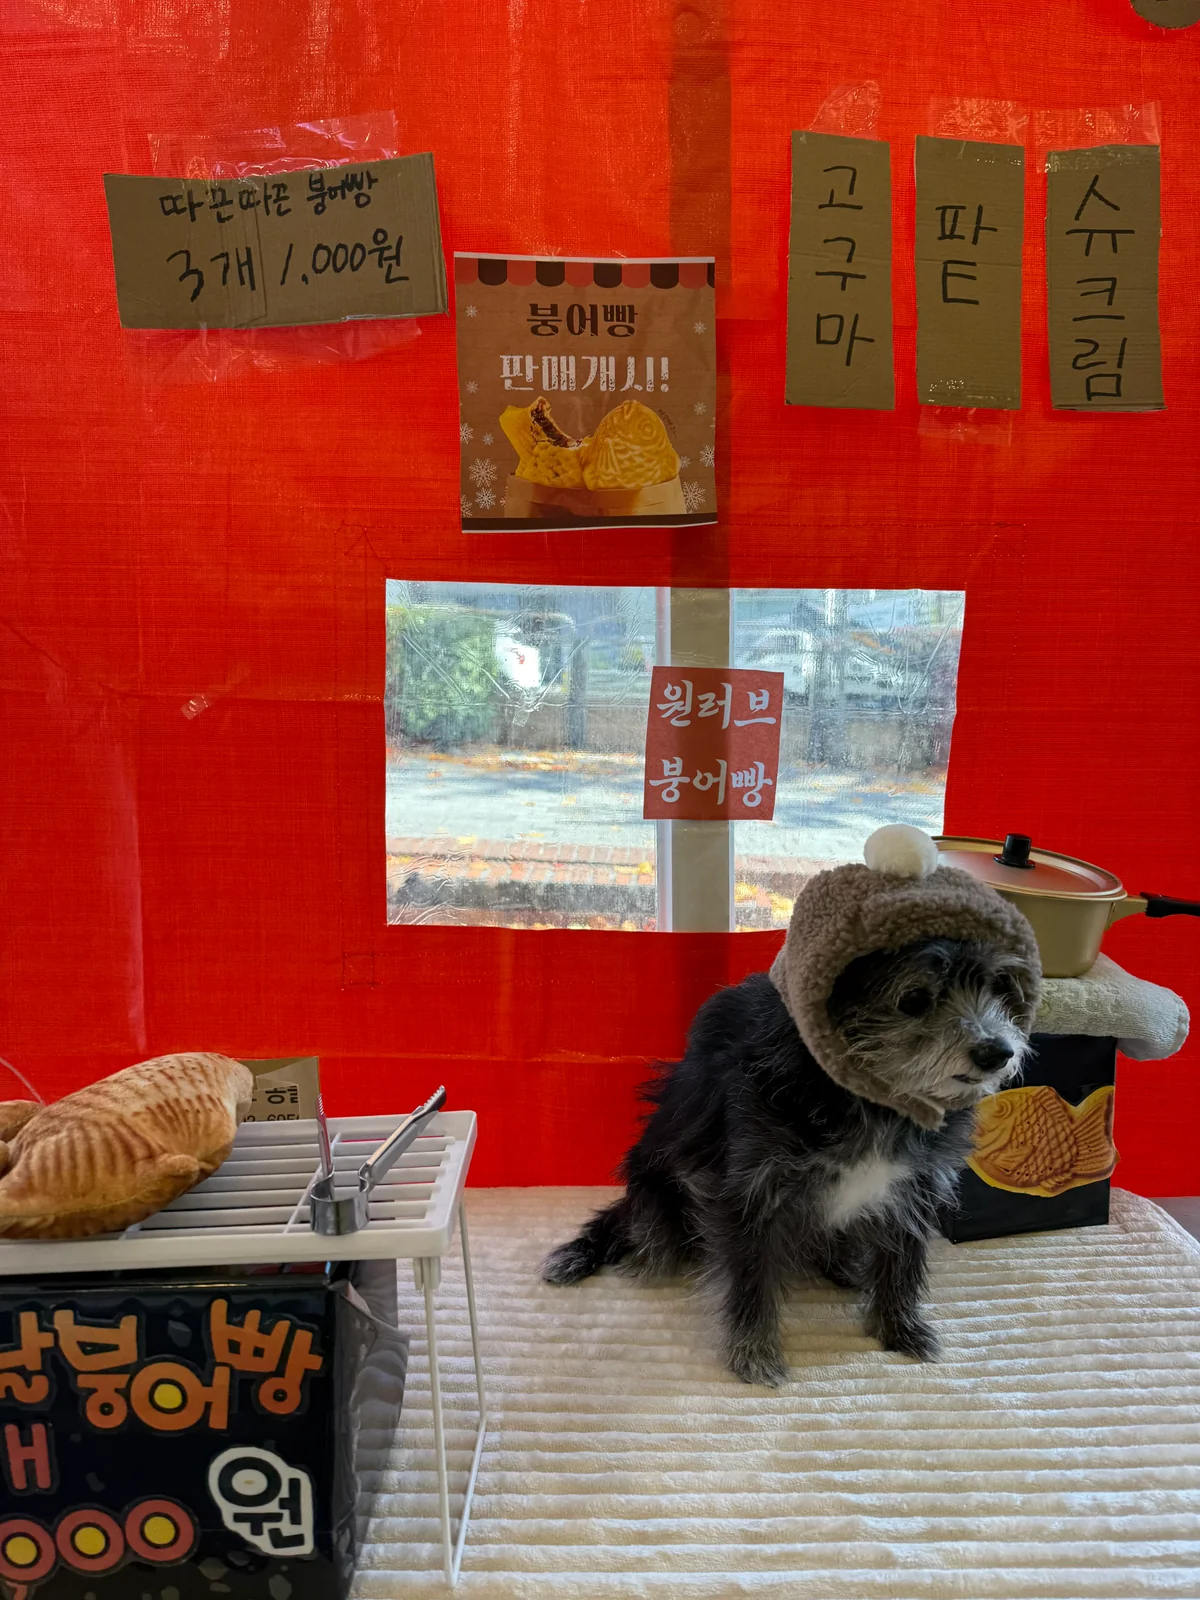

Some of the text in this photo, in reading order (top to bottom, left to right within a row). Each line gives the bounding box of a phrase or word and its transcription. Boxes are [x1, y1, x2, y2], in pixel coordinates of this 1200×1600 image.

[306, 170, 379, 216] 붕어빵
[815, 165, 876, 367] 고구마
[935, 203, 999, 307] 팥
[1065, 173, 1136, 402] 슈크림
[526, 302, 639, 338] 붕어빵
[499, 354, 670, 393] 판매개시!
[656, 679, 777, 730] 원러브
[648, 756, 774, 808] 붕어빵
